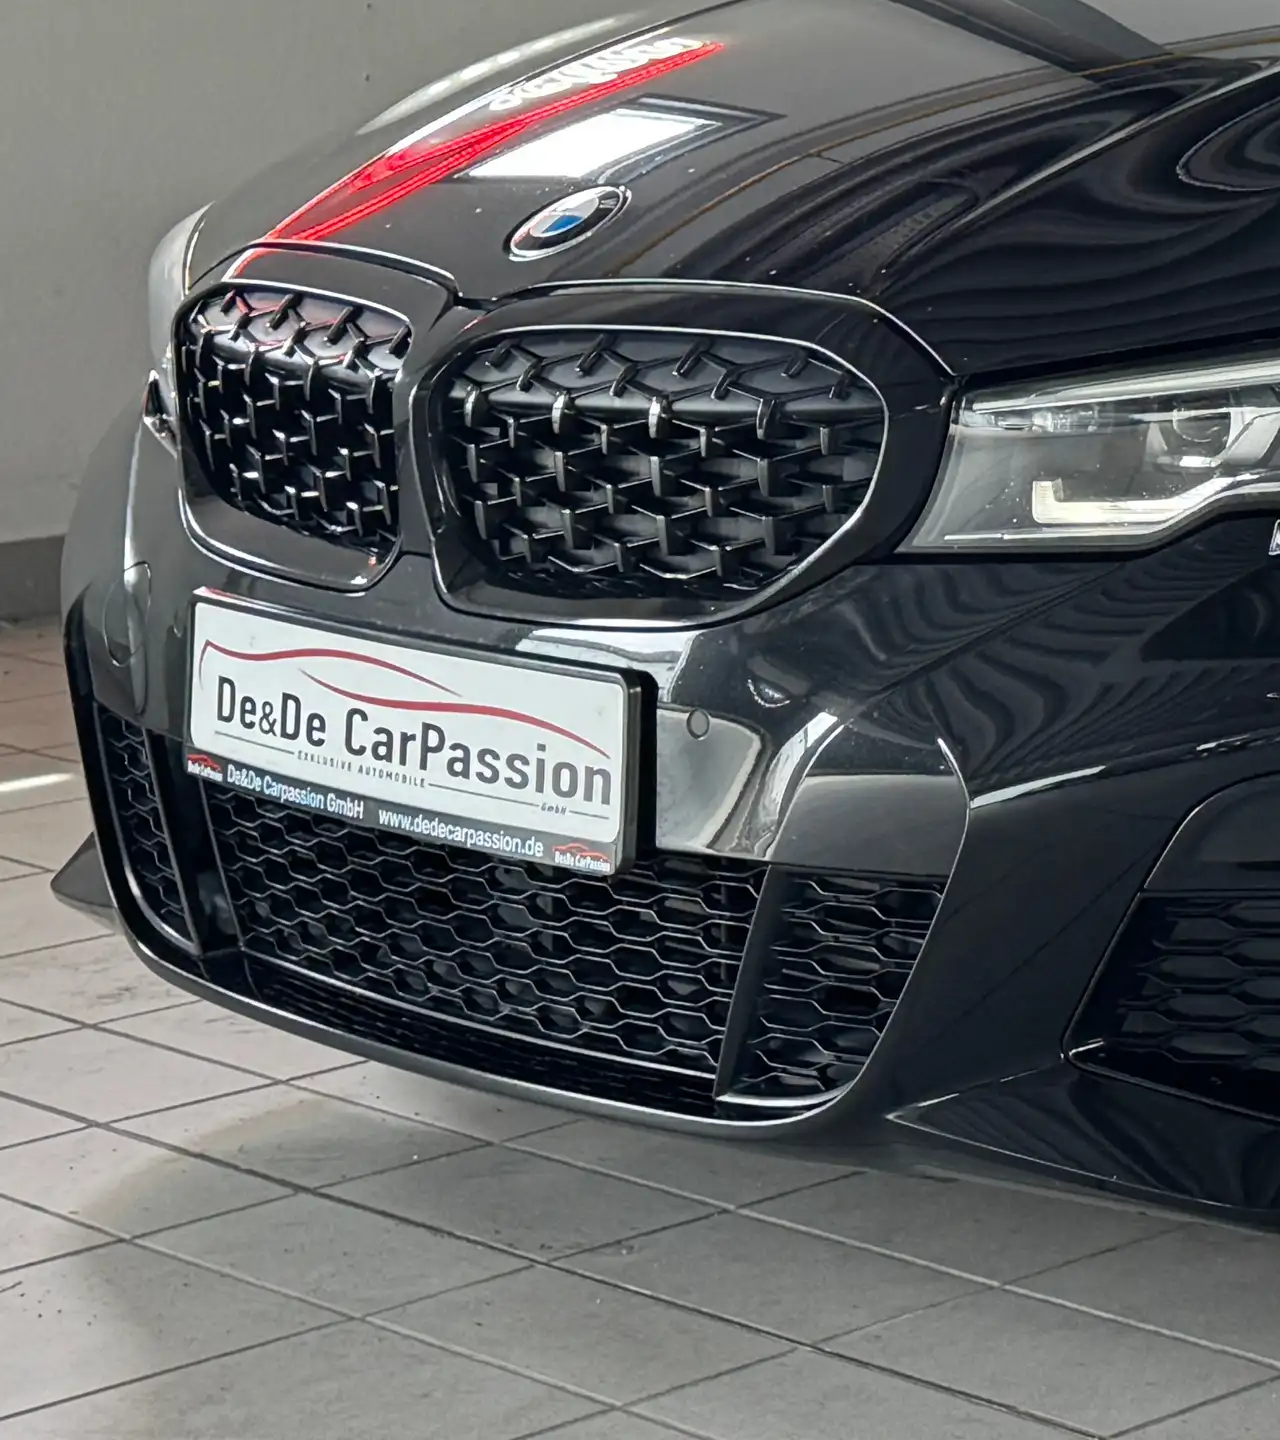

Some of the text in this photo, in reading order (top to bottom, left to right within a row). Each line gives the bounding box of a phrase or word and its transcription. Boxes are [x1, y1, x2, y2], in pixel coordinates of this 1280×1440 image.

[216, 675, 611, 806] De&De CarPassion
[227, 763, 262, 792] De&De
[263, 775, 325, 810] Carpassion
[326, 792, 364, 819] GmbH
[297, 750, 425, 788] EXKLUSIVE AUTOMOBILE
[378, 809, 544, 857] www.dedecarpassion.de
